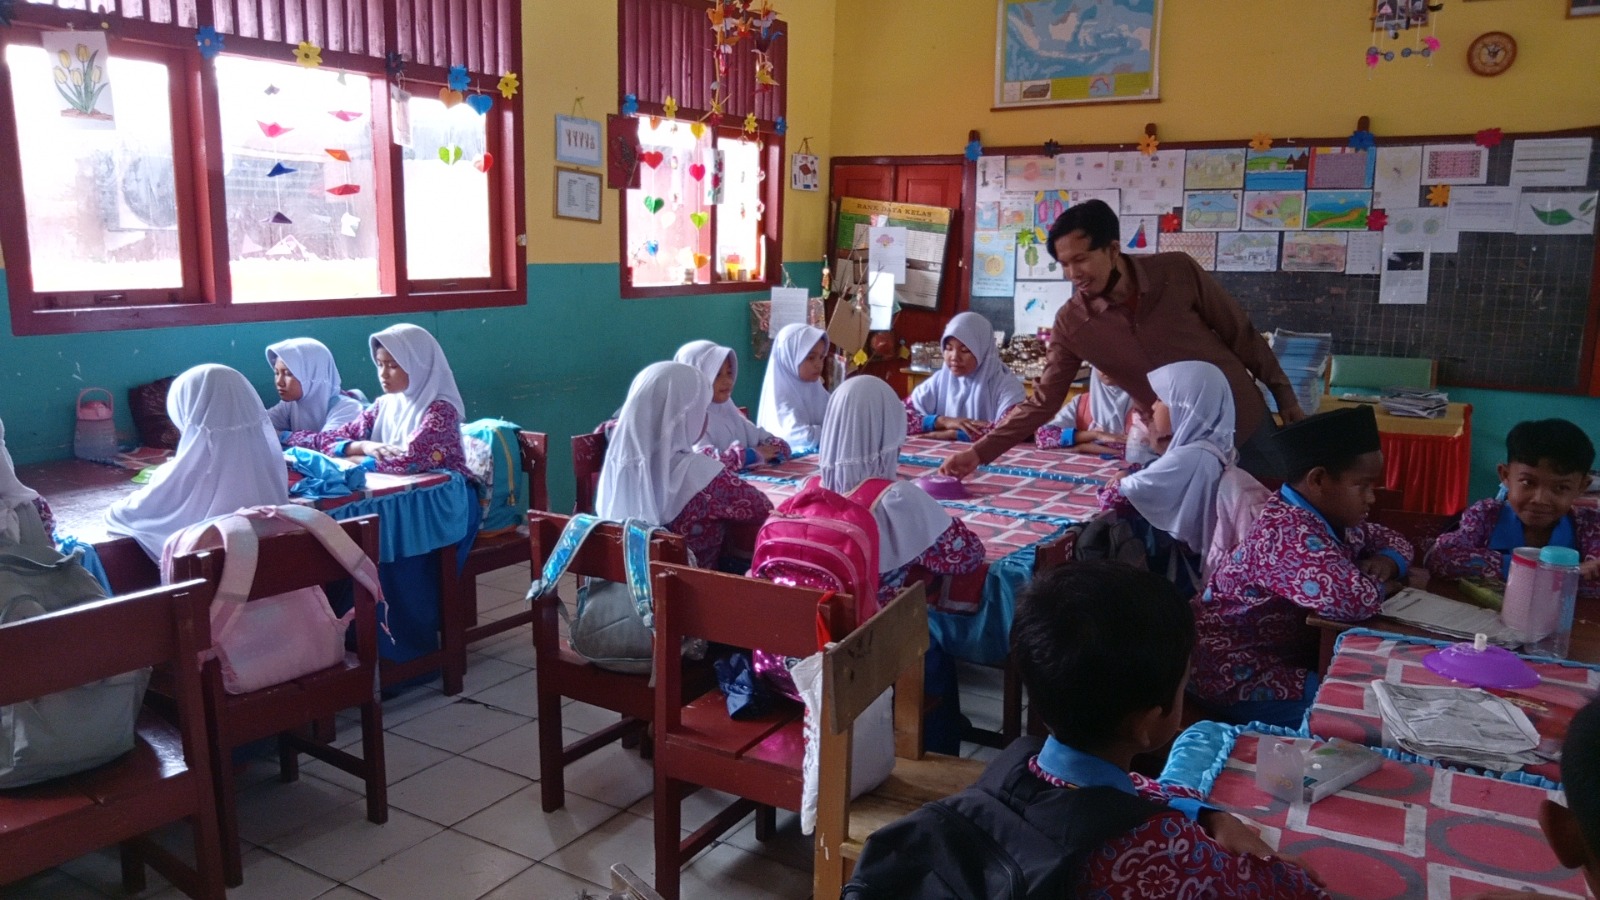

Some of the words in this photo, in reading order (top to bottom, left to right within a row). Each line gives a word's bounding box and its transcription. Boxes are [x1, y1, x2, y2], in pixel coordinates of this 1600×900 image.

[857, 203, 879, 211] BANK
[881, 206, 902, 214] DATA
[905, 209, 932, 217] KELAS
